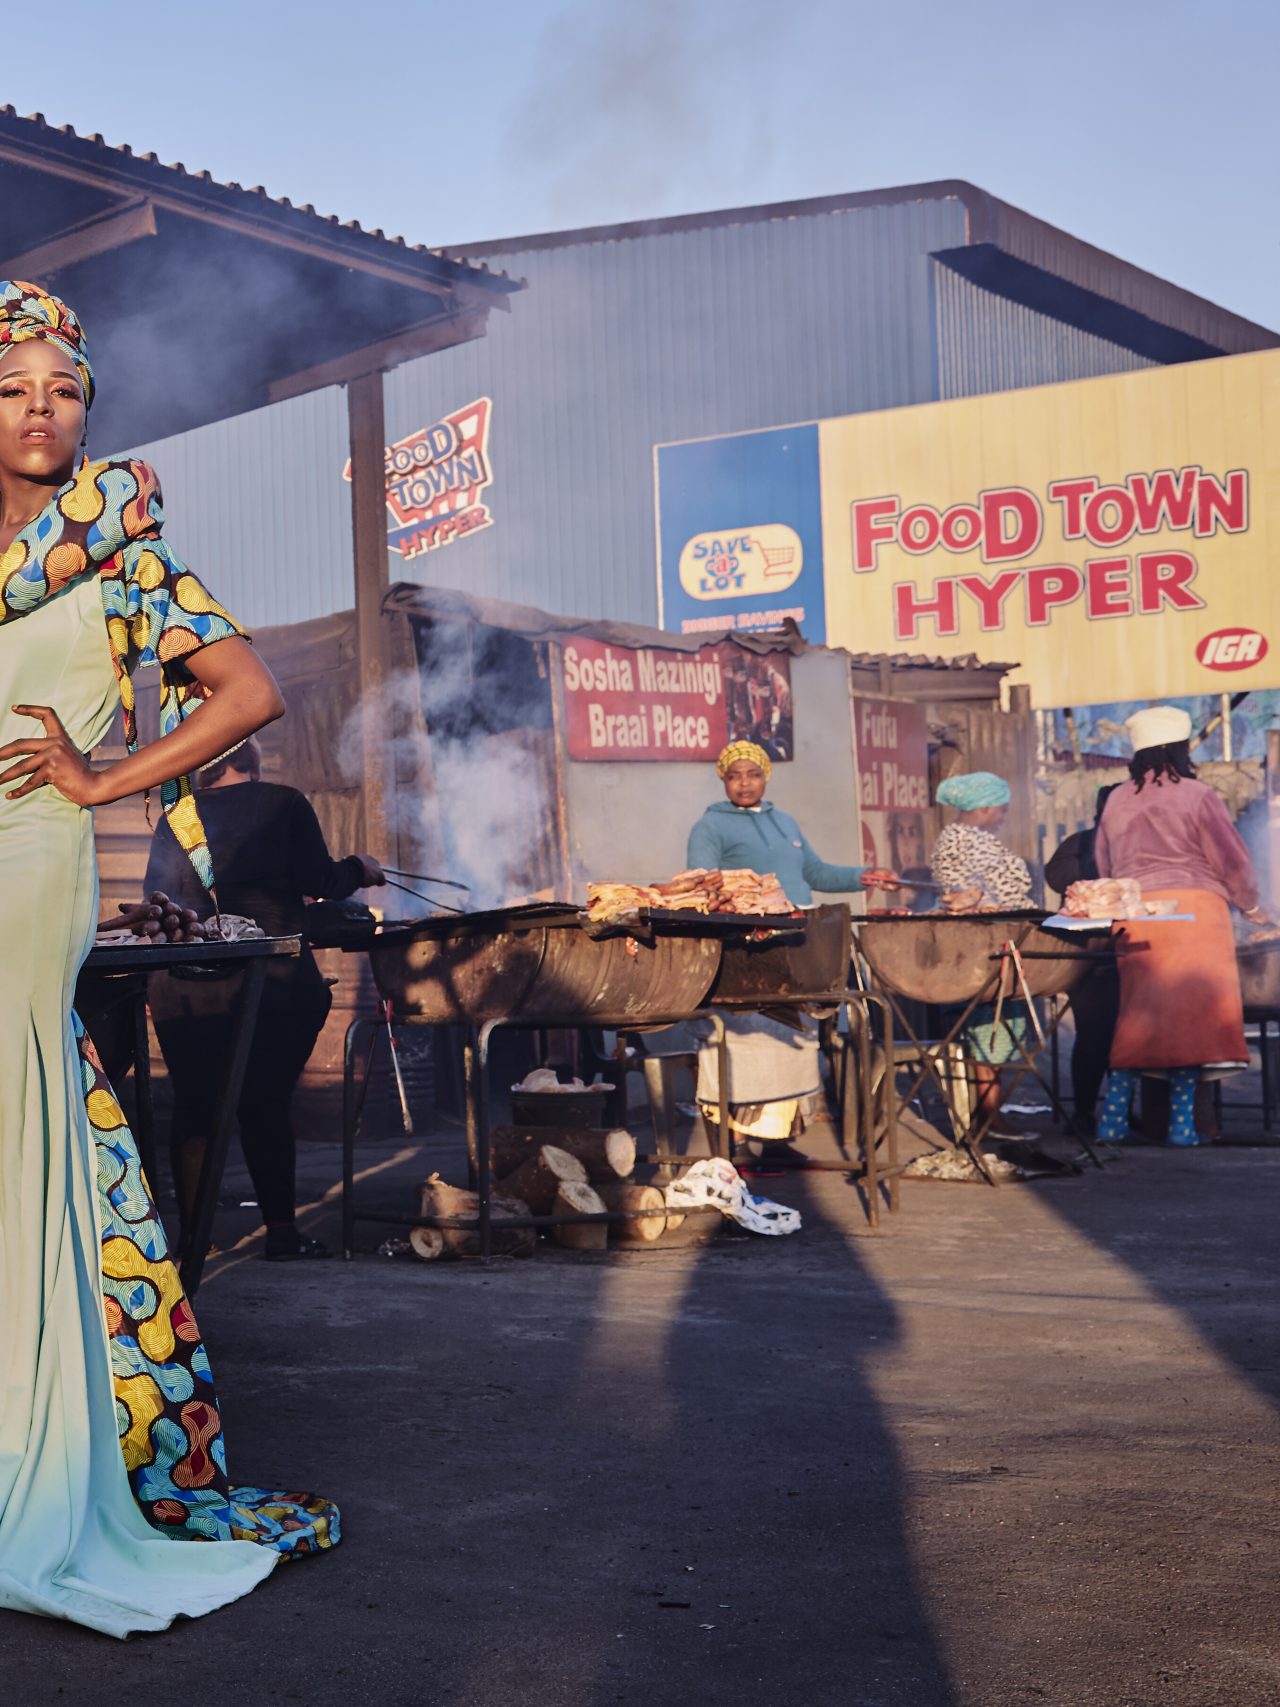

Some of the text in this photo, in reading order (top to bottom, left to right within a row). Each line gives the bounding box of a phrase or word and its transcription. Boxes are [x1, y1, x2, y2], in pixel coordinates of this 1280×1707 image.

[387, 447, 484, 509] TOWN
[1049, 465, 1249, 547] TOWN
[400, 507, 488, 557] HYPER
[693, 535, 752, 559] SAVE
[700, 573, 746, 593] LOT
[893, 549, 1207, 641] HYPER
[564, 647, 634, 692] Sosha
[1200, 633, 1263, 665] IGA
[589, 703, 710, 749] Braai Place
[862, 702, 898, 749] Fufu
[858, 762, 928, 809] ai Place
